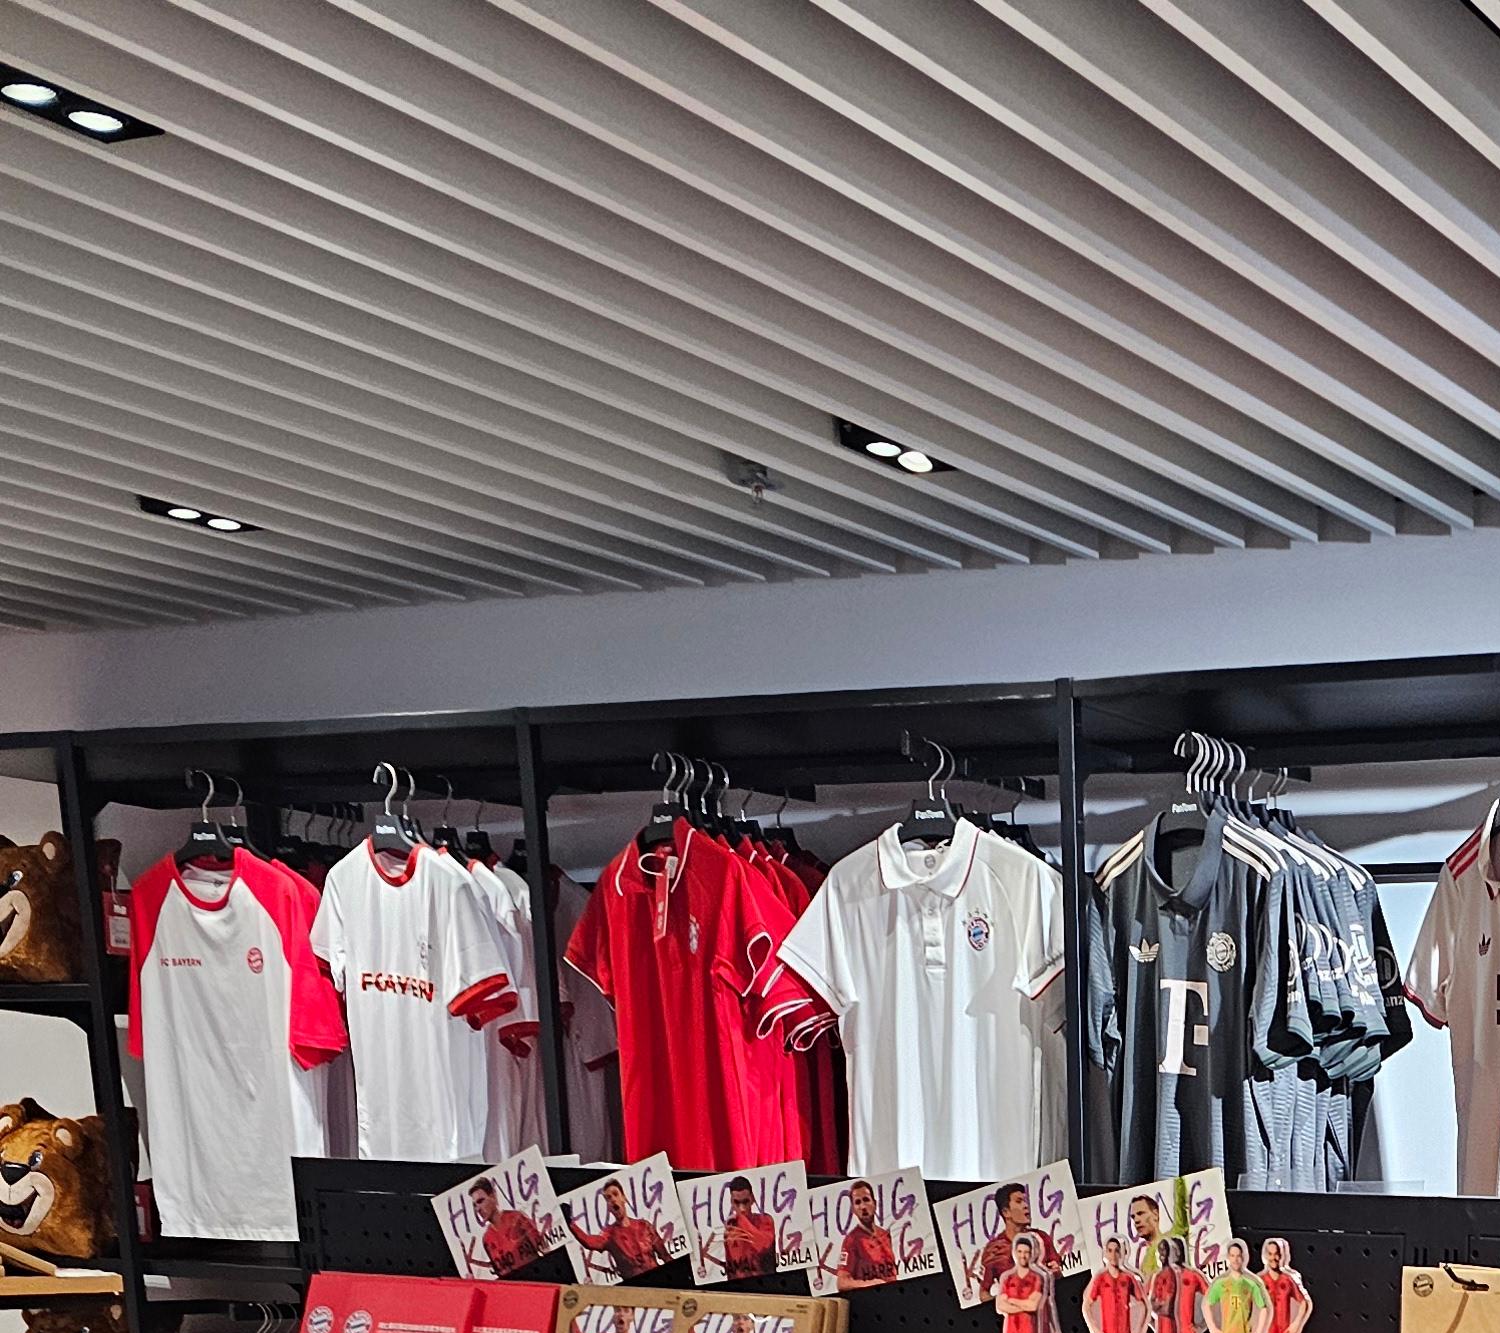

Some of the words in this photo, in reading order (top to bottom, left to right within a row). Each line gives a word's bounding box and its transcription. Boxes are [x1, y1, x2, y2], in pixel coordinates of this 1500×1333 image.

[160, 958, 169, 967] FC
[172, 958, 202, 968] BAYERN
[862, 1258, 903, 1280] HARRY
[904, 1253, 935, 1275] KANE
